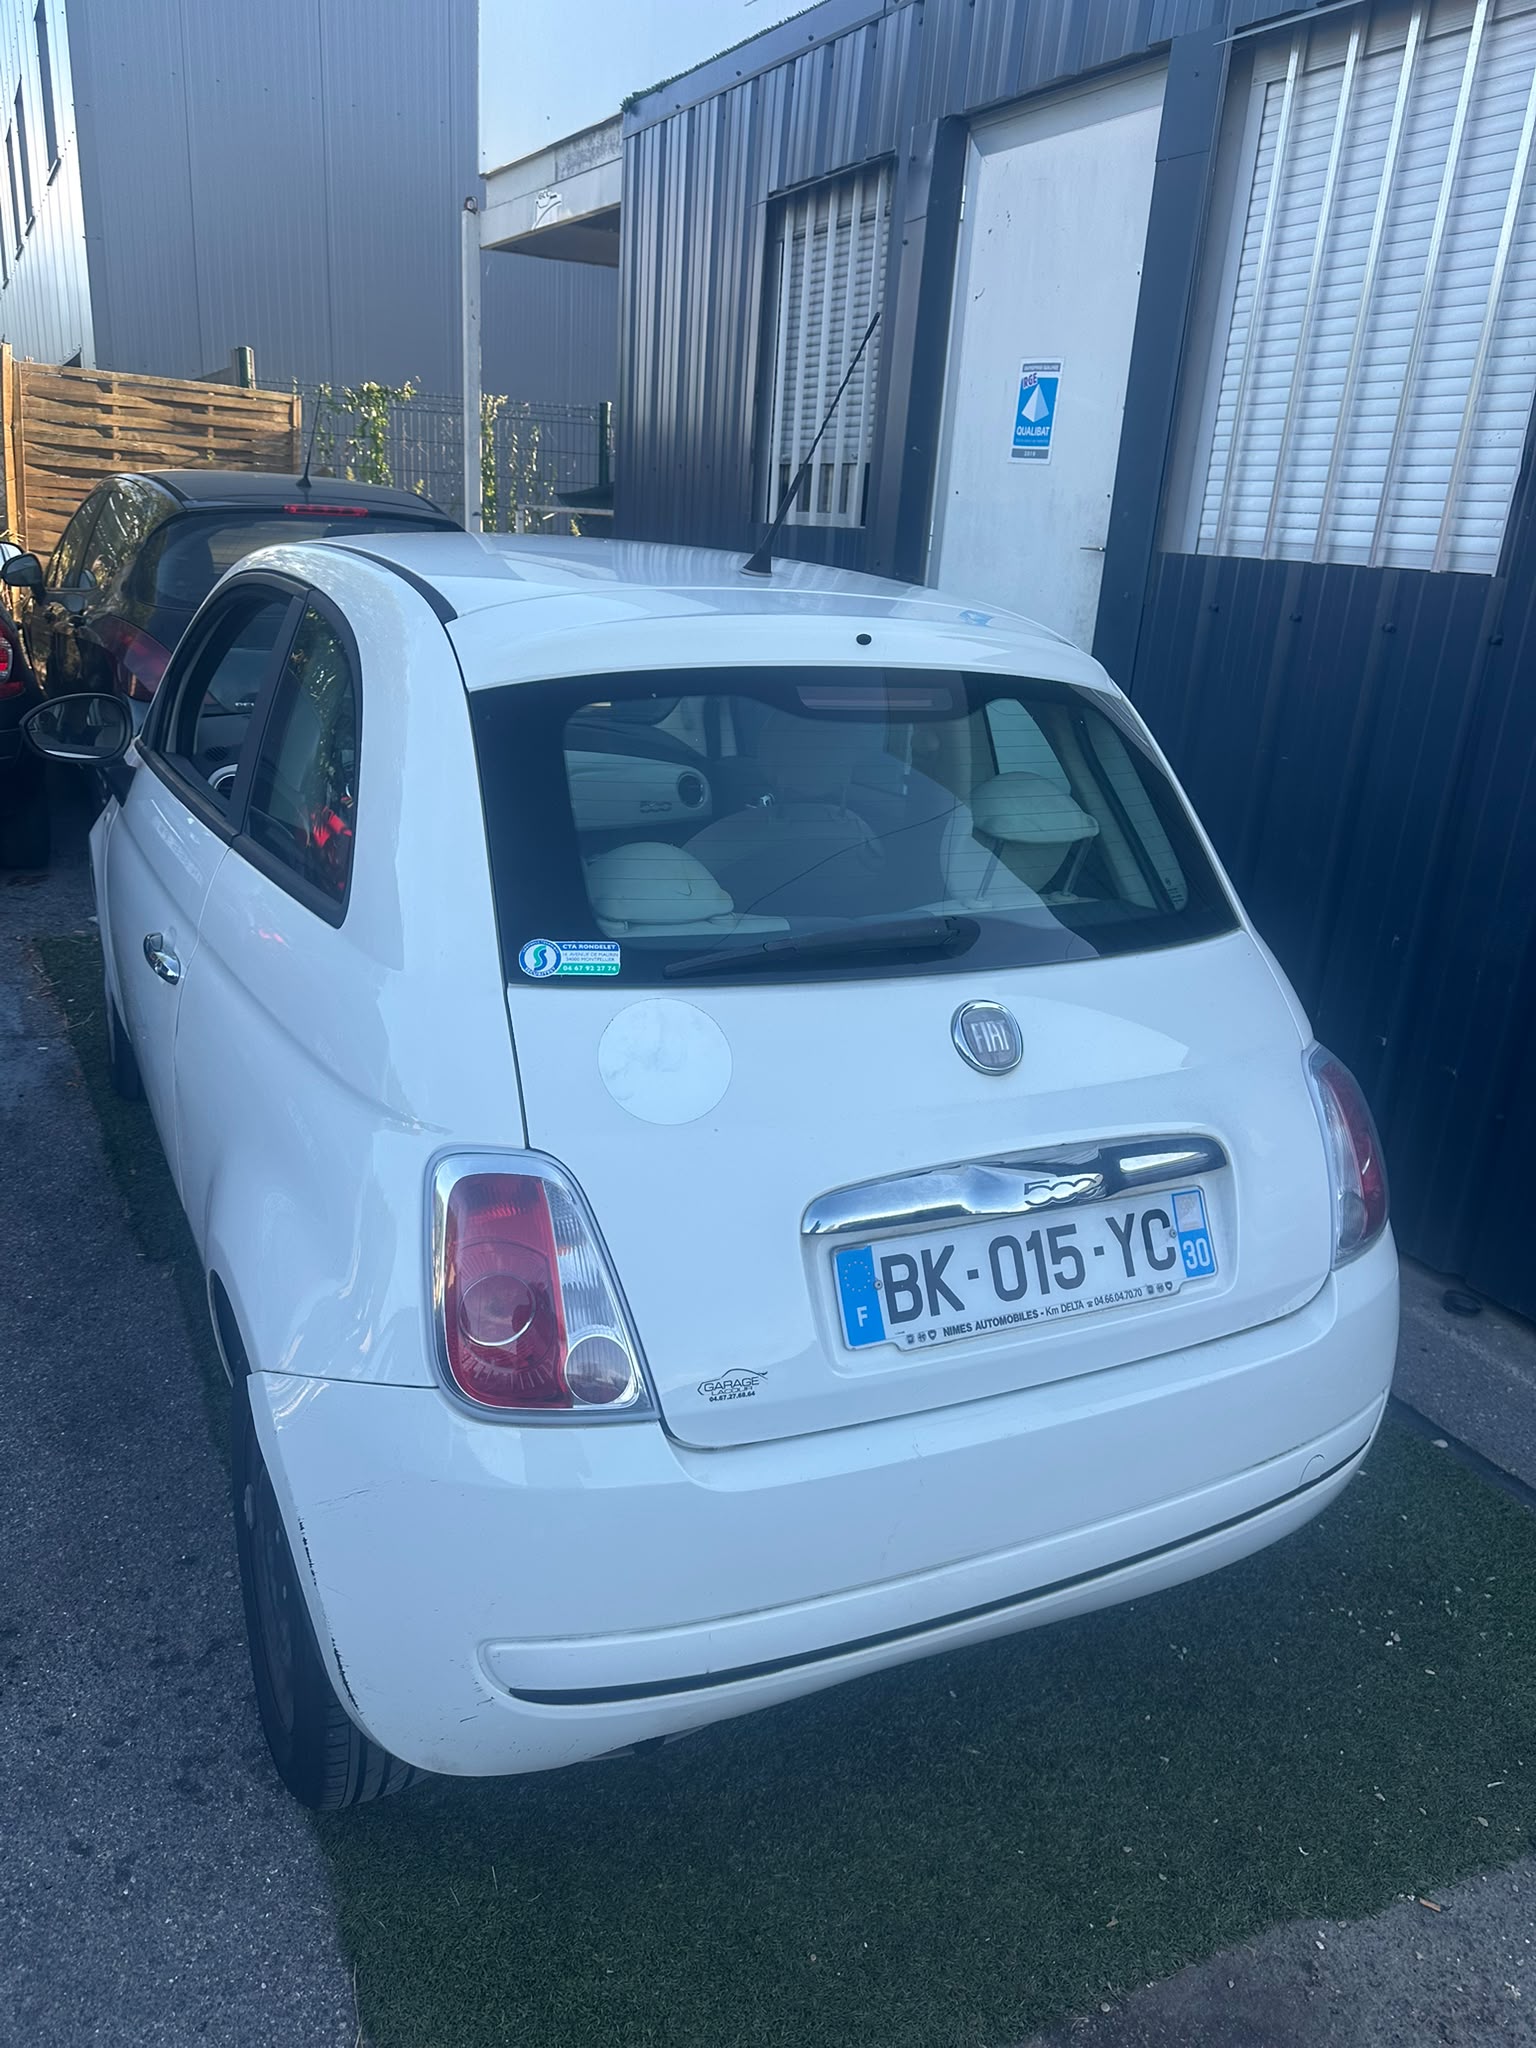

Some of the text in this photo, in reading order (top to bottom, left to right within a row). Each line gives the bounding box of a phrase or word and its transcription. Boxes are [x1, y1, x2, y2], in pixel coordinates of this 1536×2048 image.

[1016, 426, 1050, 436] QUALIBAT
[971, 1020, 1010, 1053] FIAT
[1024, 1176, 1104, 1206] 500
[880, 1208, 1177, 1325] BK-015-YC
[1183, 1237, 1211, 1270] 30
[857, 1305, 868, 1328] F
[943, 1322, 973, 1337] NIMES
[975, 1309, 1039, 1331] AUTOMOBILES
[1045, 1307, 1059, 1317] Km
[1061, 1300, 1085, 1313] DELTA
[1094, 1287, 1143, 1306] 04.66.04.70.70
[703, 1376, 760, 1392] GARAGE
